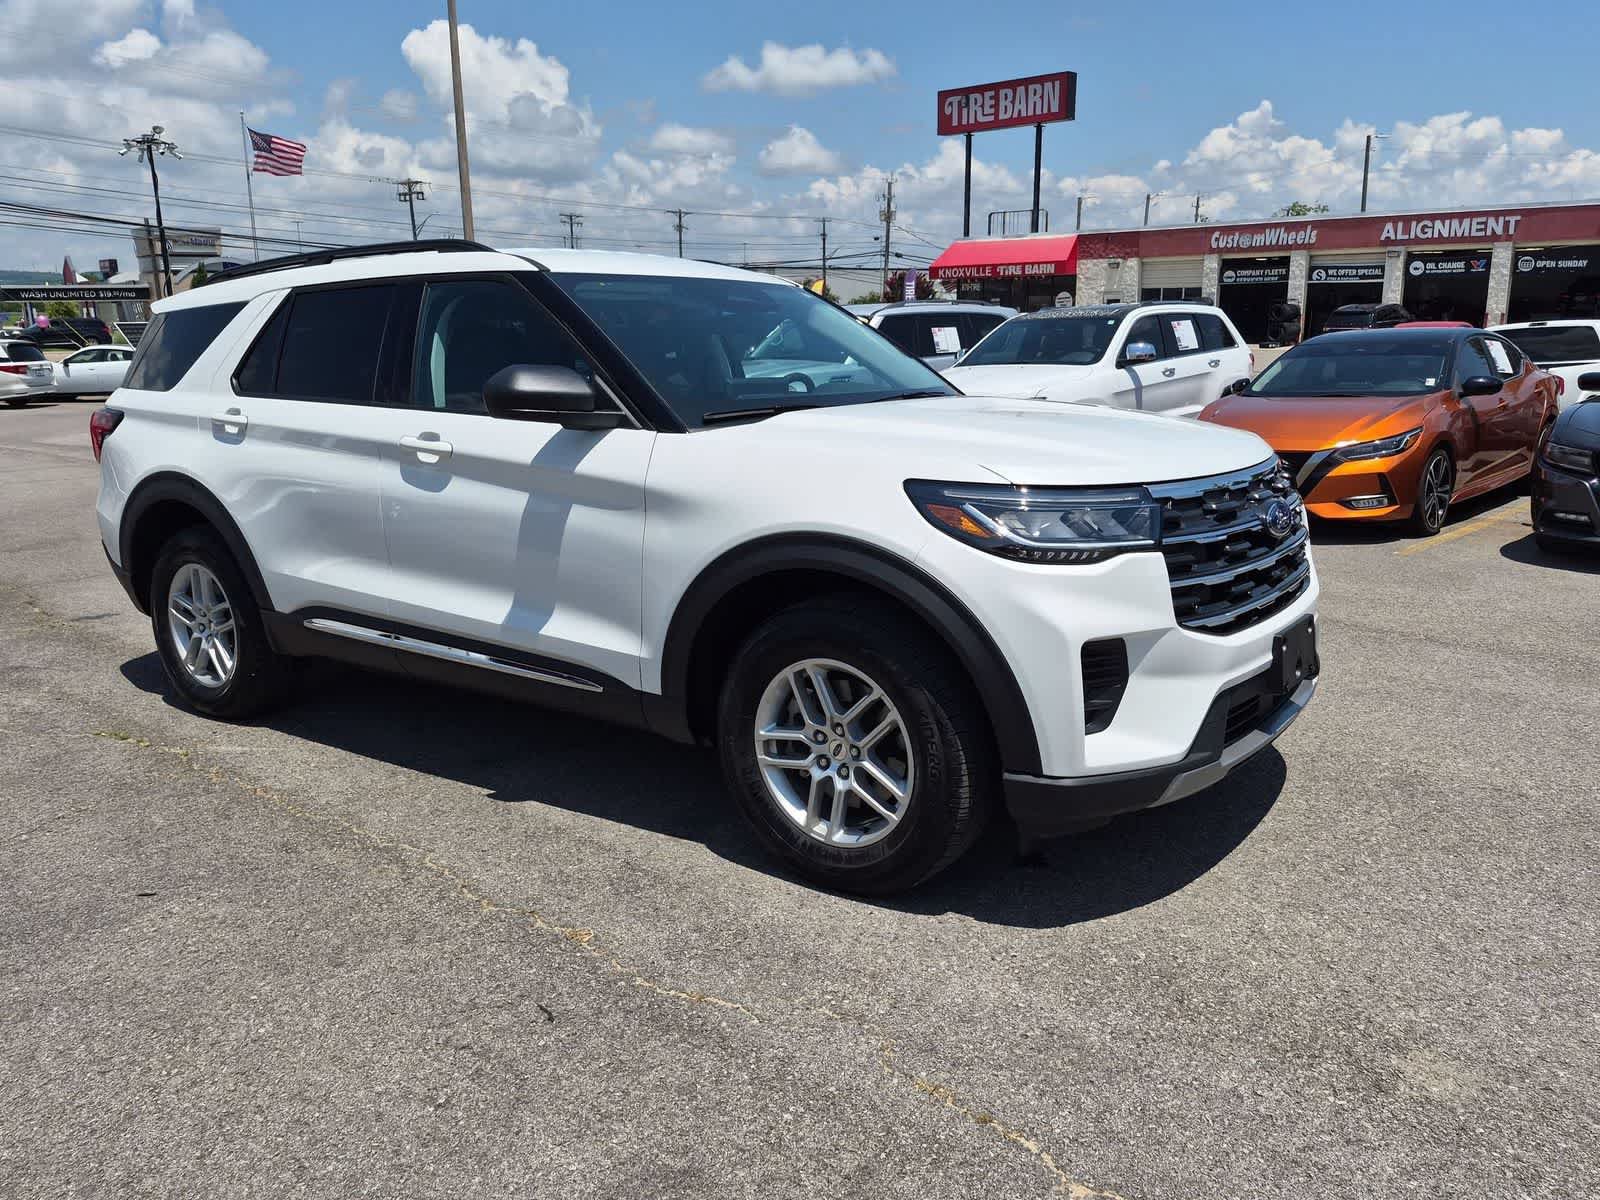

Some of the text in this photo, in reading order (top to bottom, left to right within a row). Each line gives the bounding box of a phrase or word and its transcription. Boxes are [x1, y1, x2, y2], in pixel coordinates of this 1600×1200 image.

[998, 80, 1060, 121] BARN
[1380, 215, 1521, 241] ALIGNMENT
[1438, 261, 1466, 269] CHANGE
[1558, 259, 1588, 267] SUNDAY
[938, 266, 992, 278] KNOXVILLE
[1024, 263, 1055, 275] BARN
[1265, 268, 1288, 276] FLEETS
[1338, 268, 1357, 276] OFFER
